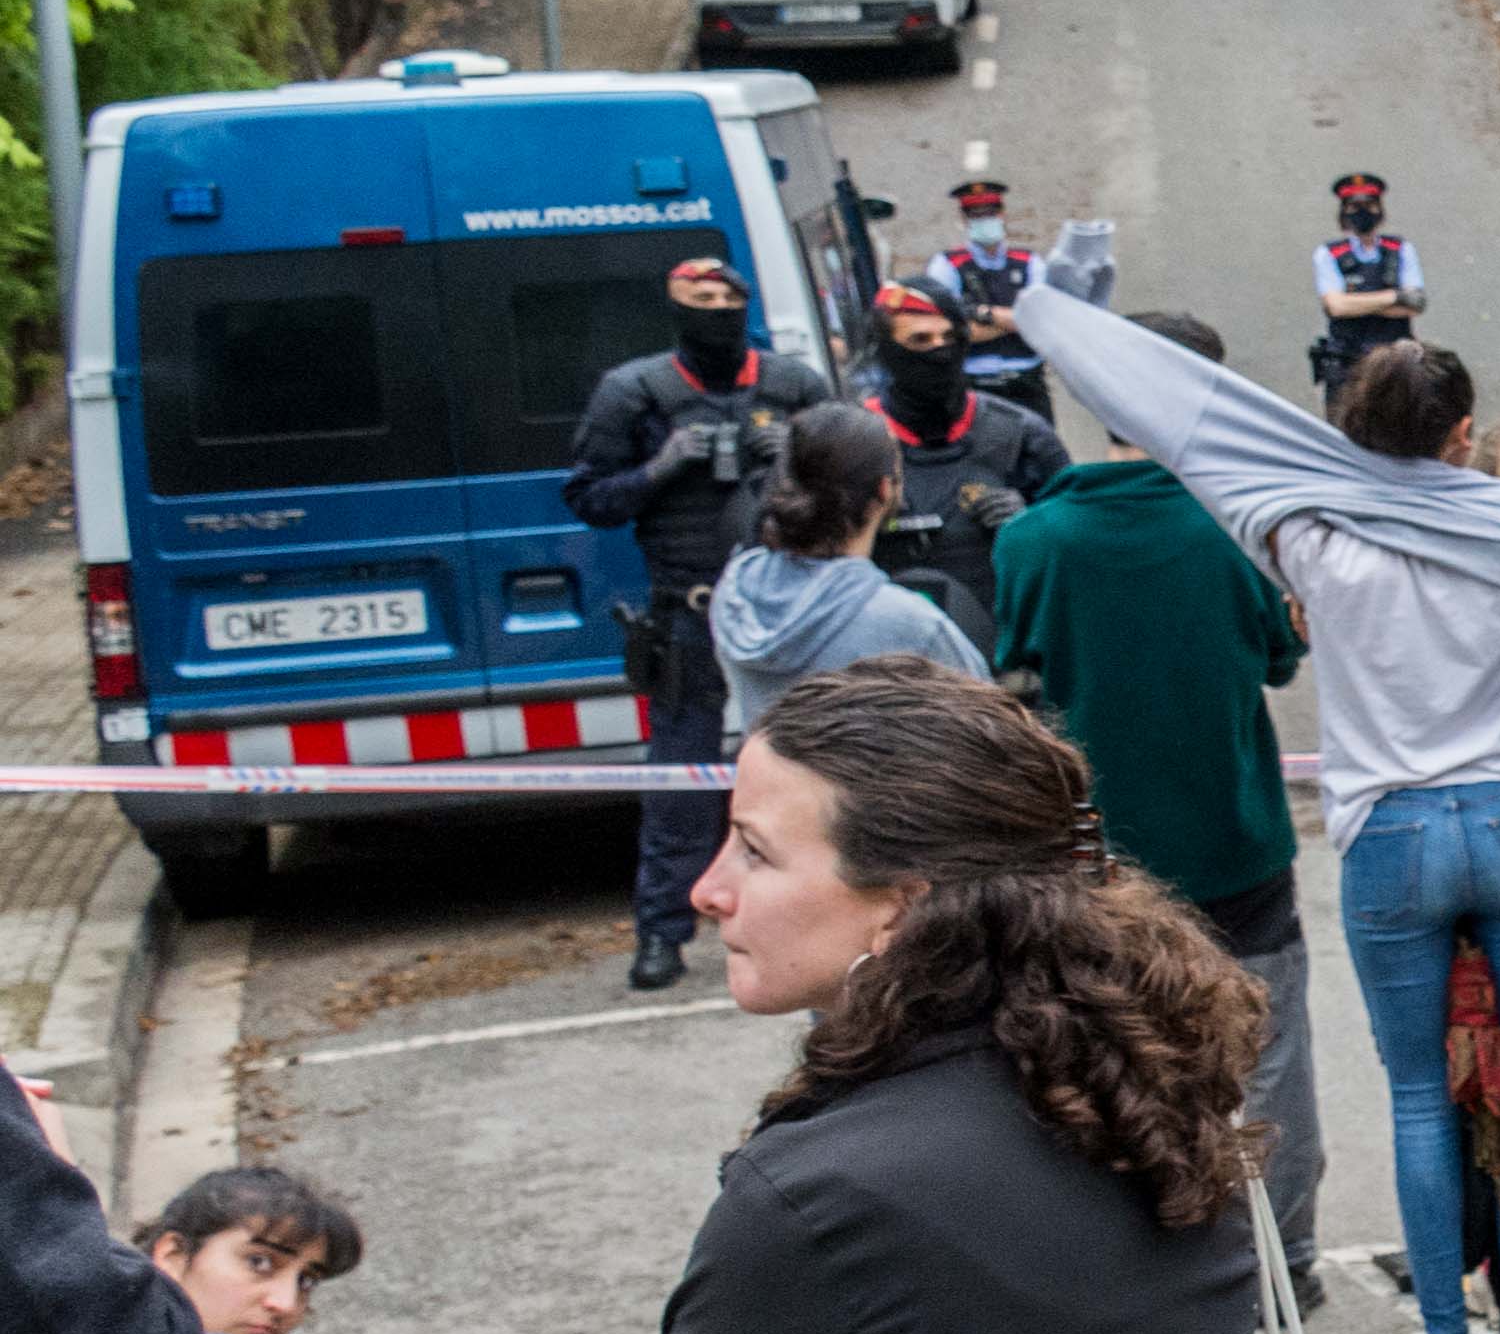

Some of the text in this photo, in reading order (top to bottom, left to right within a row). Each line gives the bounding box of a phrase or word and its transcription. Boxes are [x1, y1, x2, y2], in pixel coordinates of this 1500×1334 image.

[463, 196, 713, 232] www.mossos.cat
[223, 600, 410, 642] CME 2315
